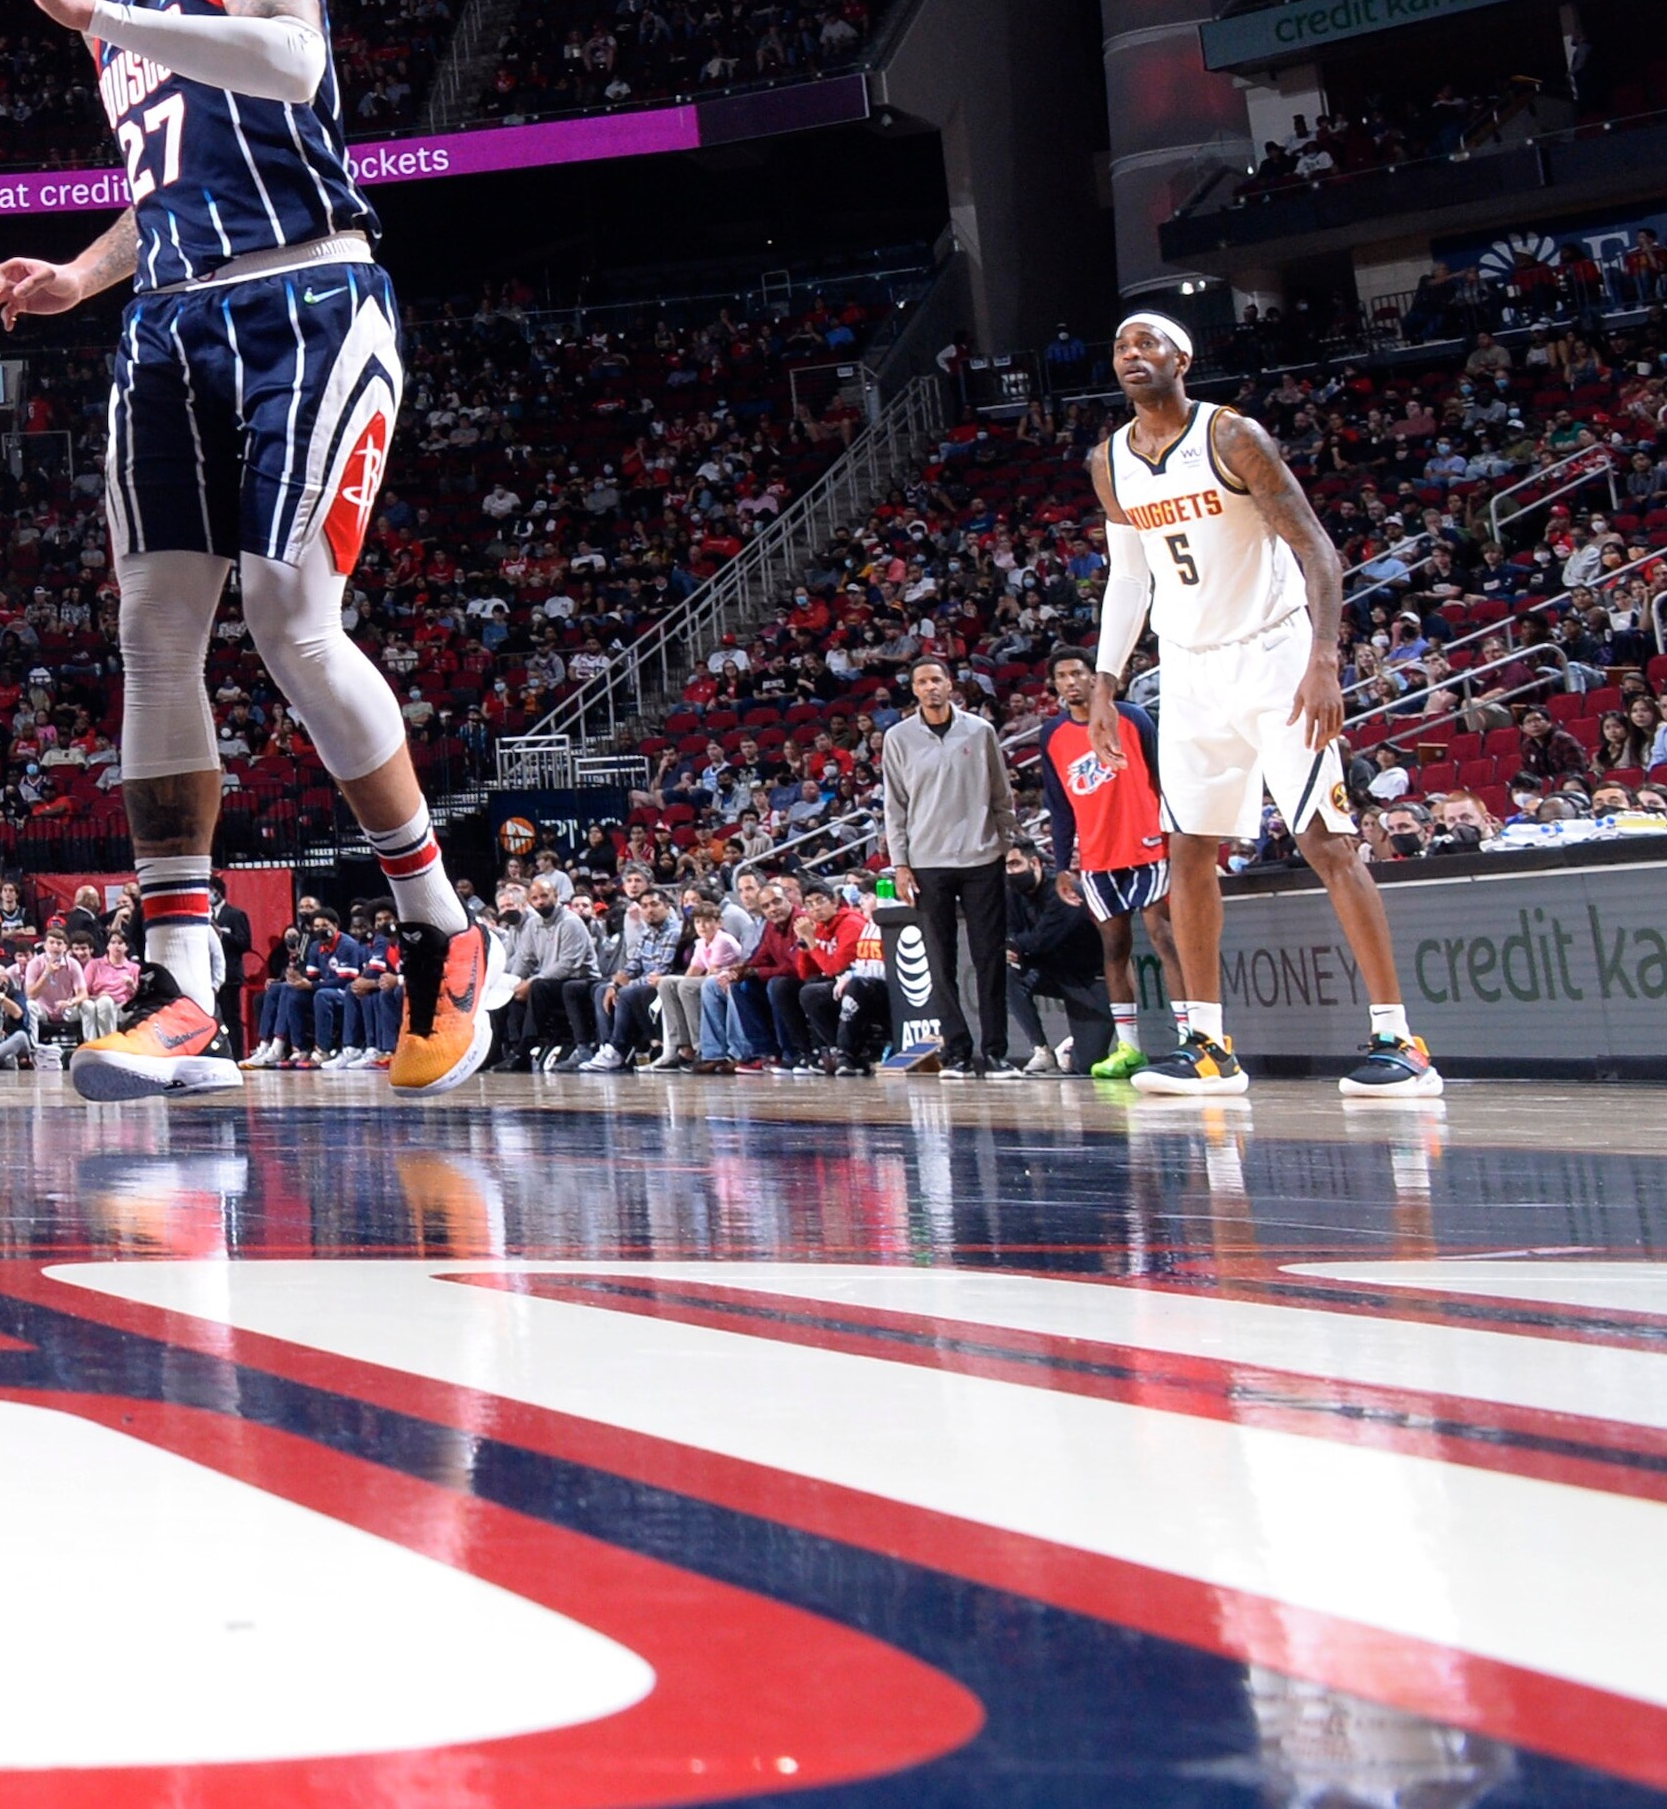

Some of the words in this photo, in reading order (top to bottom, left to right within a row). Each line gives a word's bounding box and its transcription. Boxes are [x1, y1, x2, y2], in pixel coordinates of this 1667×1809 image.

[0, 185, 30, 209] at
[346, 143, 450, 180] ockets
[117, 92, 185, 206] 27
[1125, 489, 1223, 531] NUGGETS
[1164, 533, 1200, 586] 5
[1415, 906, 1583, 1005] credit
